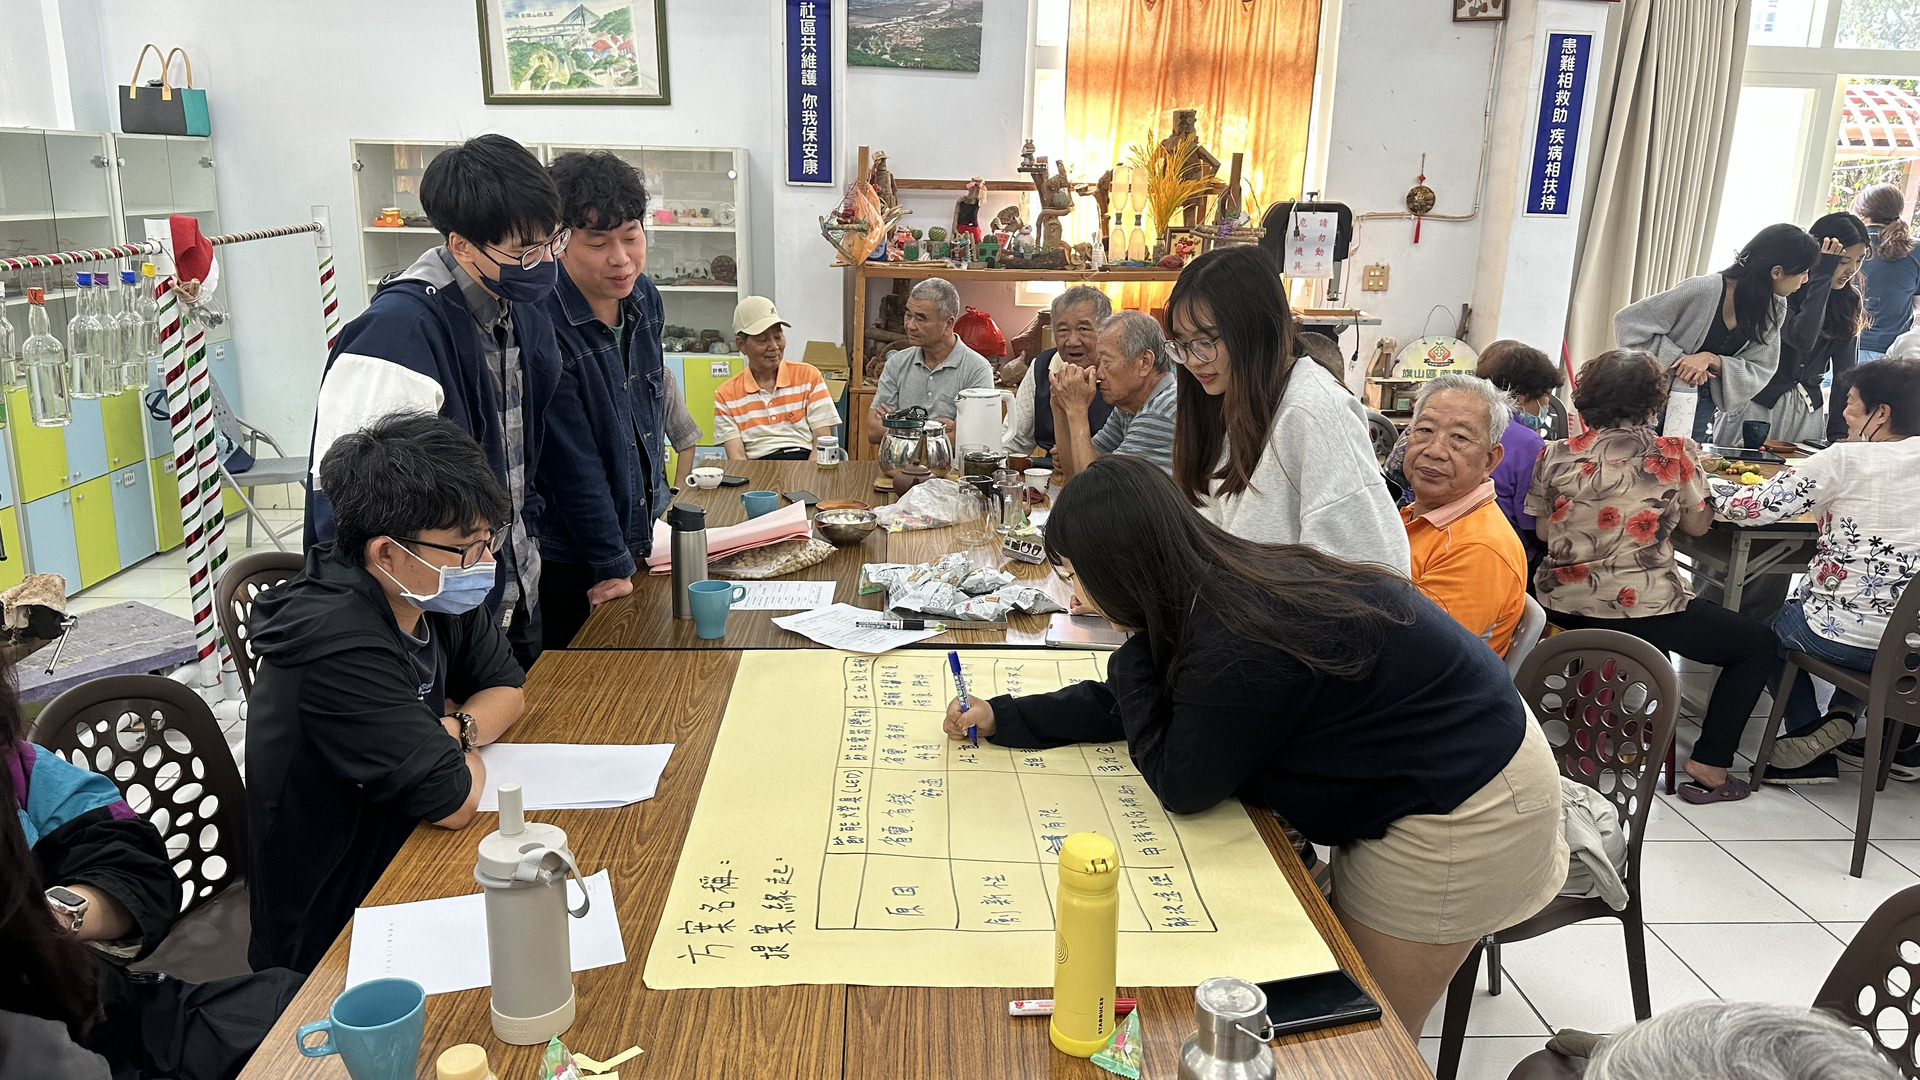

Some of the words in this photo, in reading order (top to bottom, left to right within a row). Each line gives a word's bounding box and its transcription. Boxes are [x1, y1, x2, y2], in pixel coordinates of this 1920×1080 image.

[799, 1, 818, 86] 社區共維護
[1551, 37, 1577, 123] 患難相救助
[801, 93, 818, 175] 你我保安康
[1539, 127, 1565, 211] 疾病相扶持
[1315, 218, 1328, 270] 請勿動手
[1402, 368, 1437, 379] 旗山區
